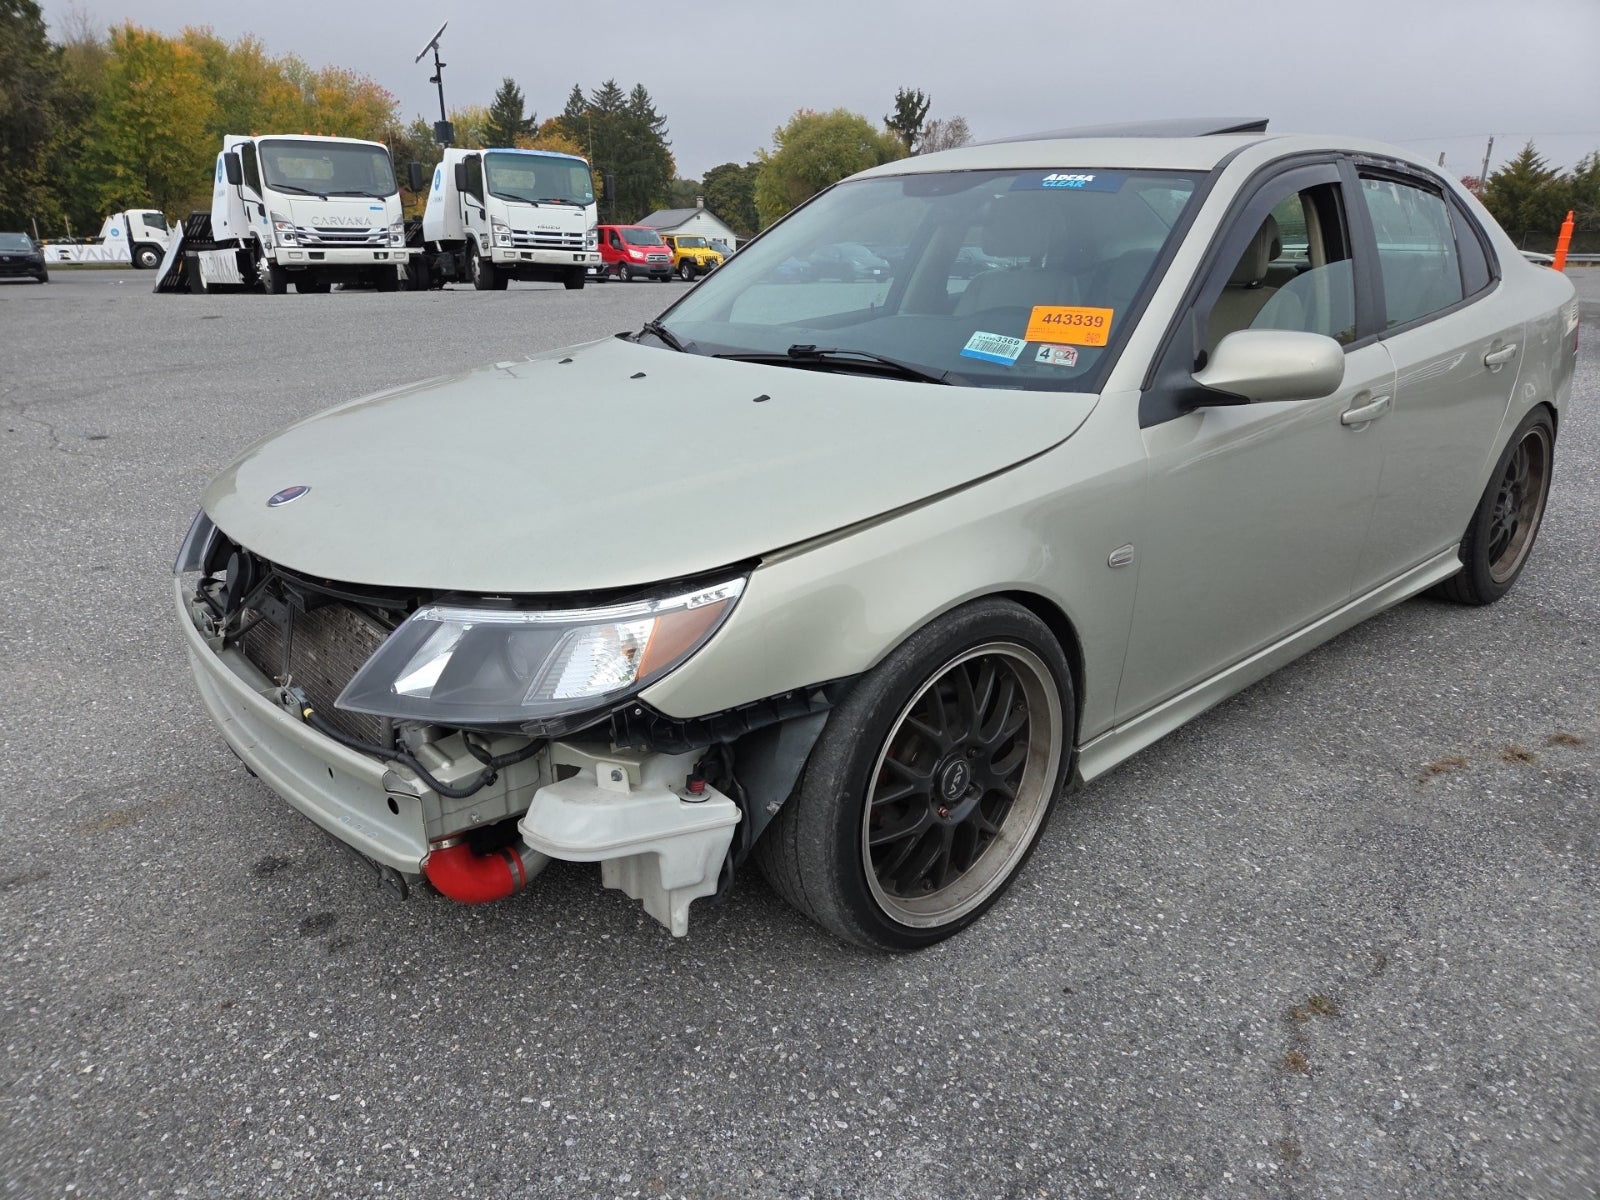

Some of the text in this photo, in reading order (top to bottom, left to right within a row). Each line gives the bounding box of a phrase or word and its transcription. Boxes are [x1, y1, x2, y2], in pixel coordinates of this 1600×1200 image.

[311, 216, 372, 226] CARVANA
[1042, 313, 1104, 328] 443339
[1040, 347, 1076, 360] 4 21
